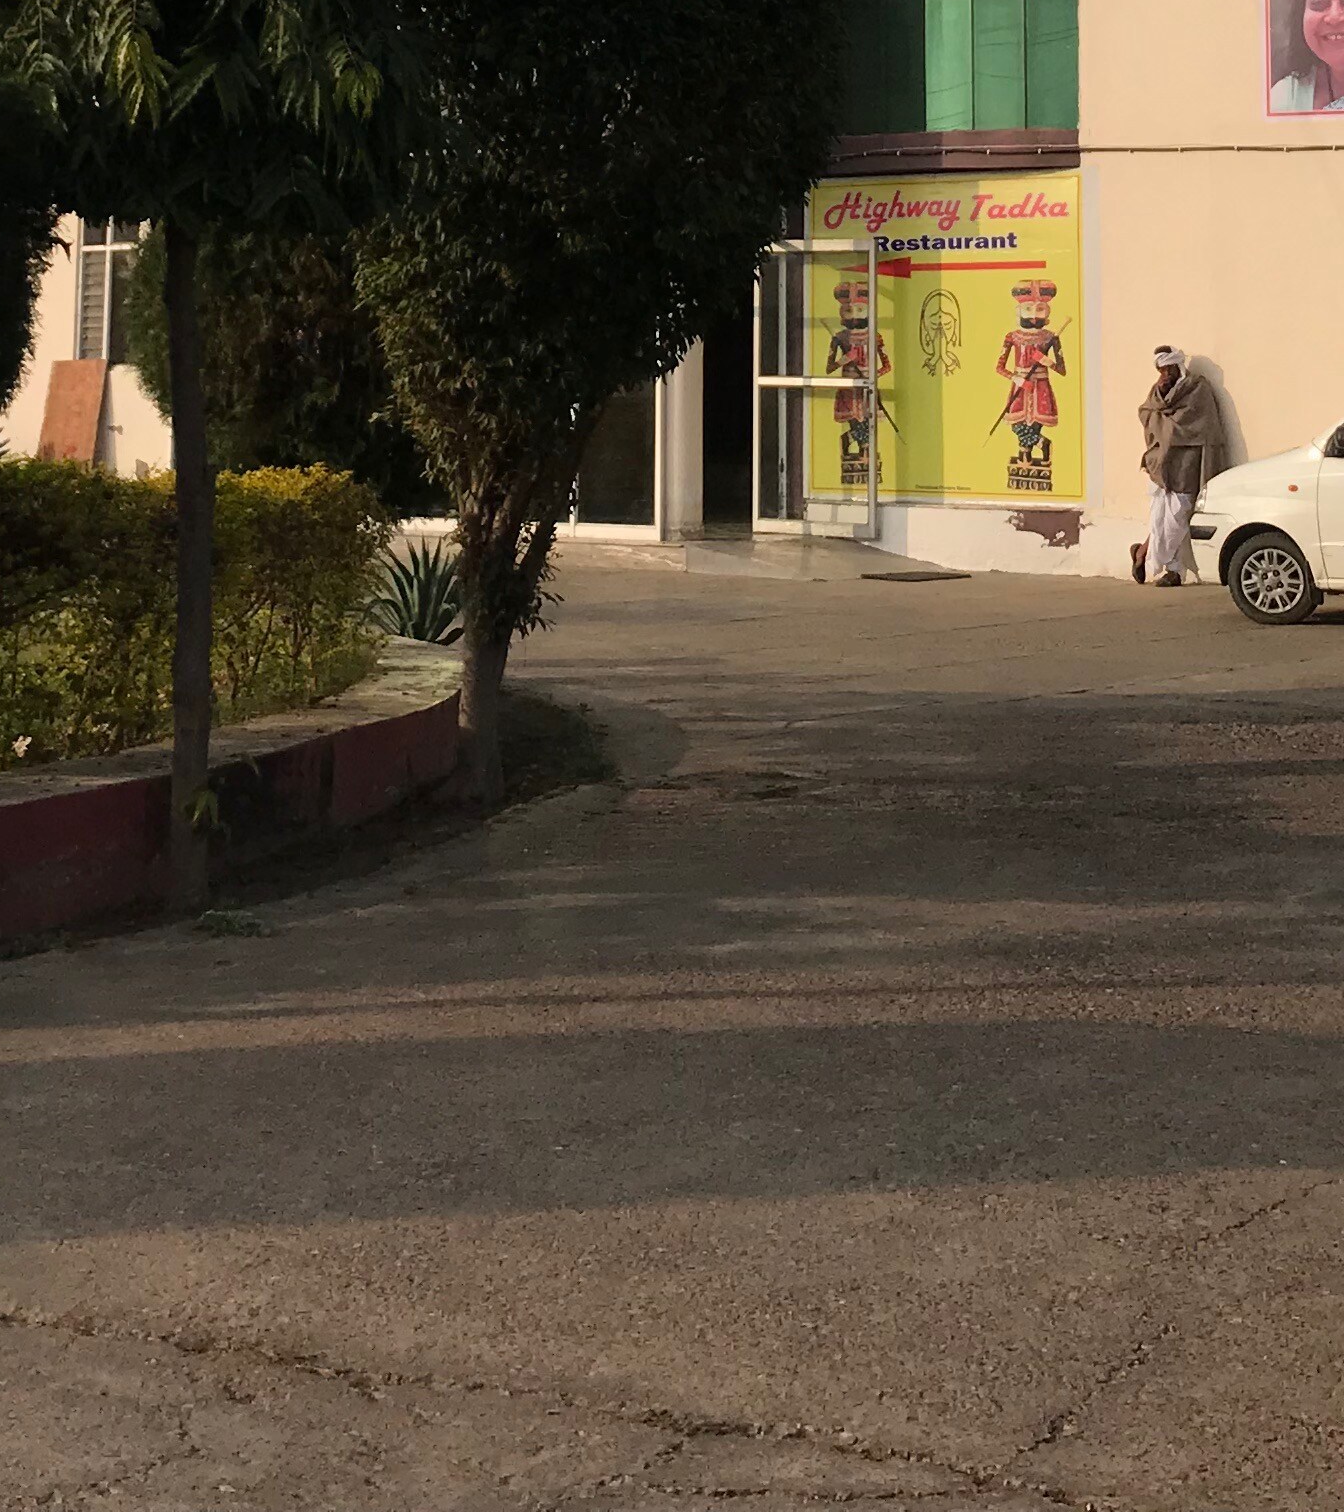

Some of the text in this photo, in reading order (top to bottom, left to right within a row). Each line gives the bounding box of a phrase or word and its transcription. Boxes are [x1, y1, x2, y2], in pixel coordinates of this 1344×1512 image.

[824, 190, 1069, 233] Highway Tadka
[873, 232, 1018, 252] Restaurant
